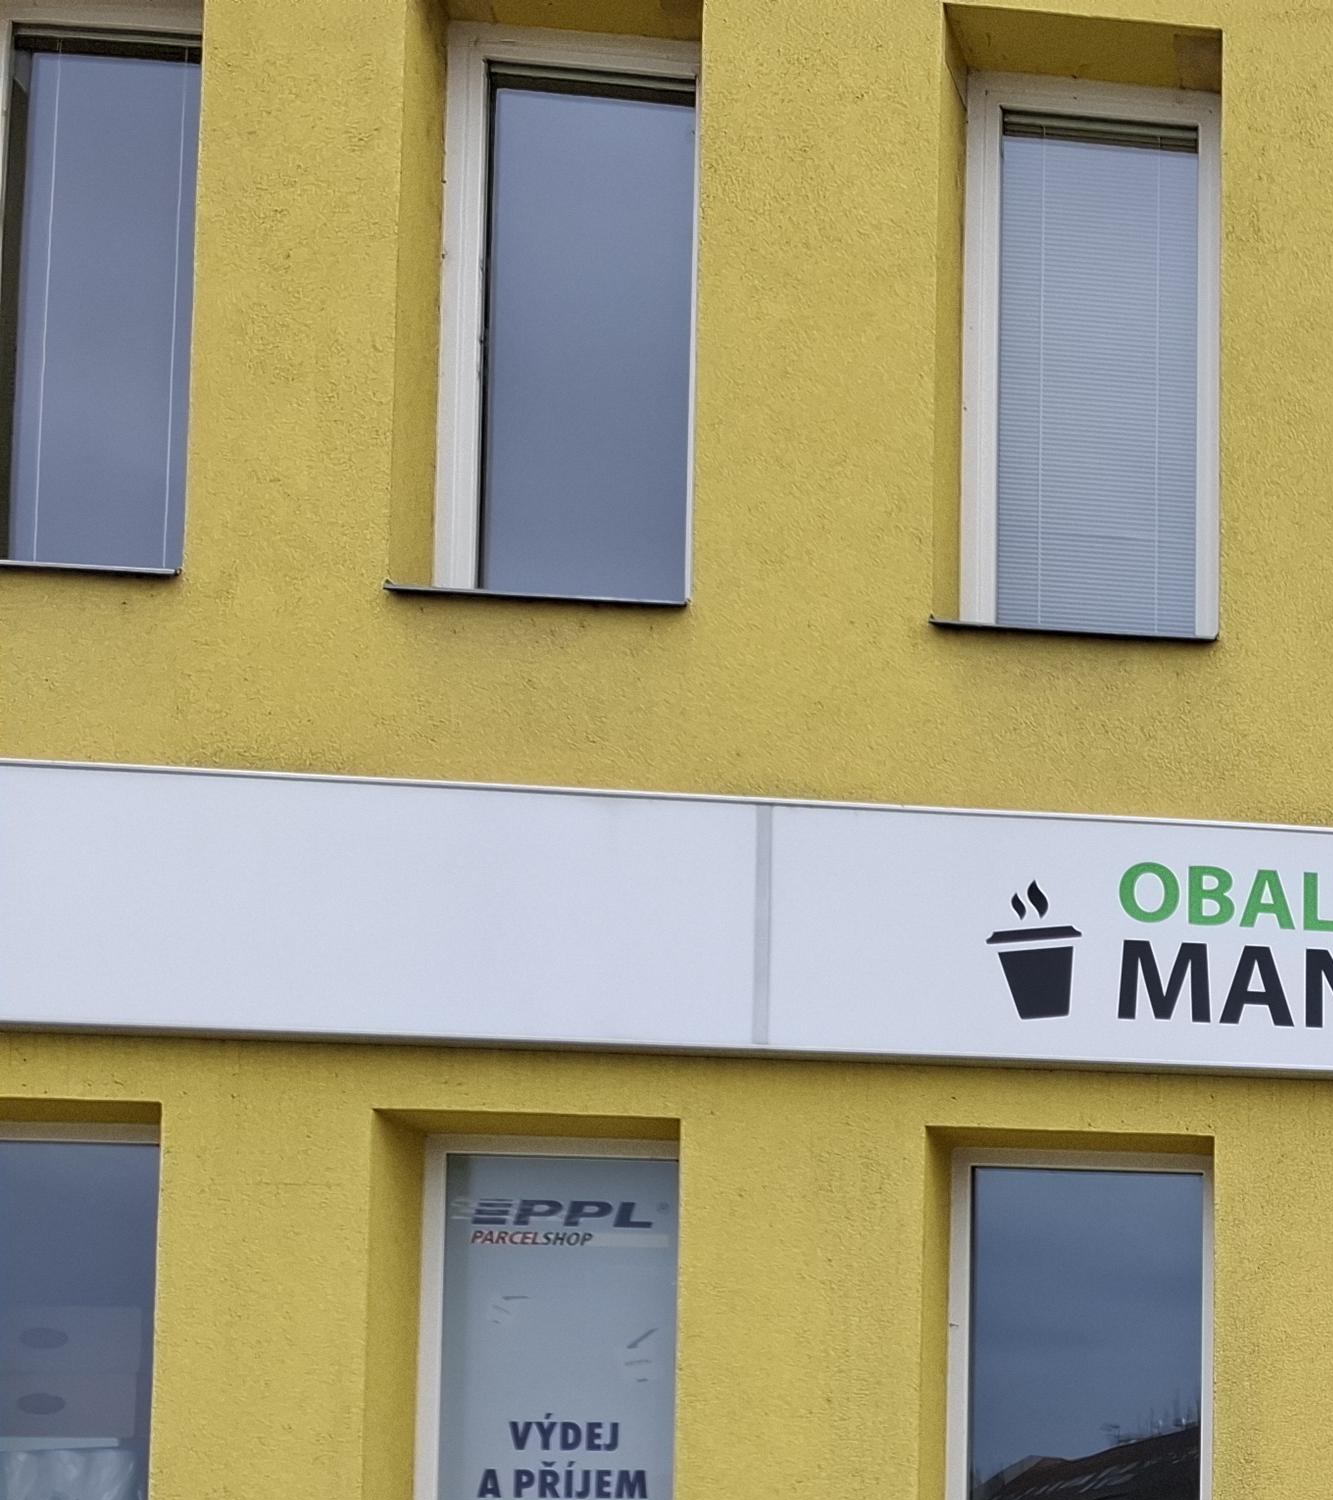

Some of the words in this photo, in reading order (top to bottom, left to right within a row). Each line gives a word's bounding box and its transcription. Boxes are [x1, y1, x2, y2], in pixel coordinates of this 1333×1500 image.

[513, 1199, 654, 1229] PPL
[470, 1230, 594, 1247] PARCELSHOP
[509, 1412, 620, 1451] VÝDEJ
[477, 1468, 501, 1498] A
[513, 1461, 648, 1499] PŘÍJEM
